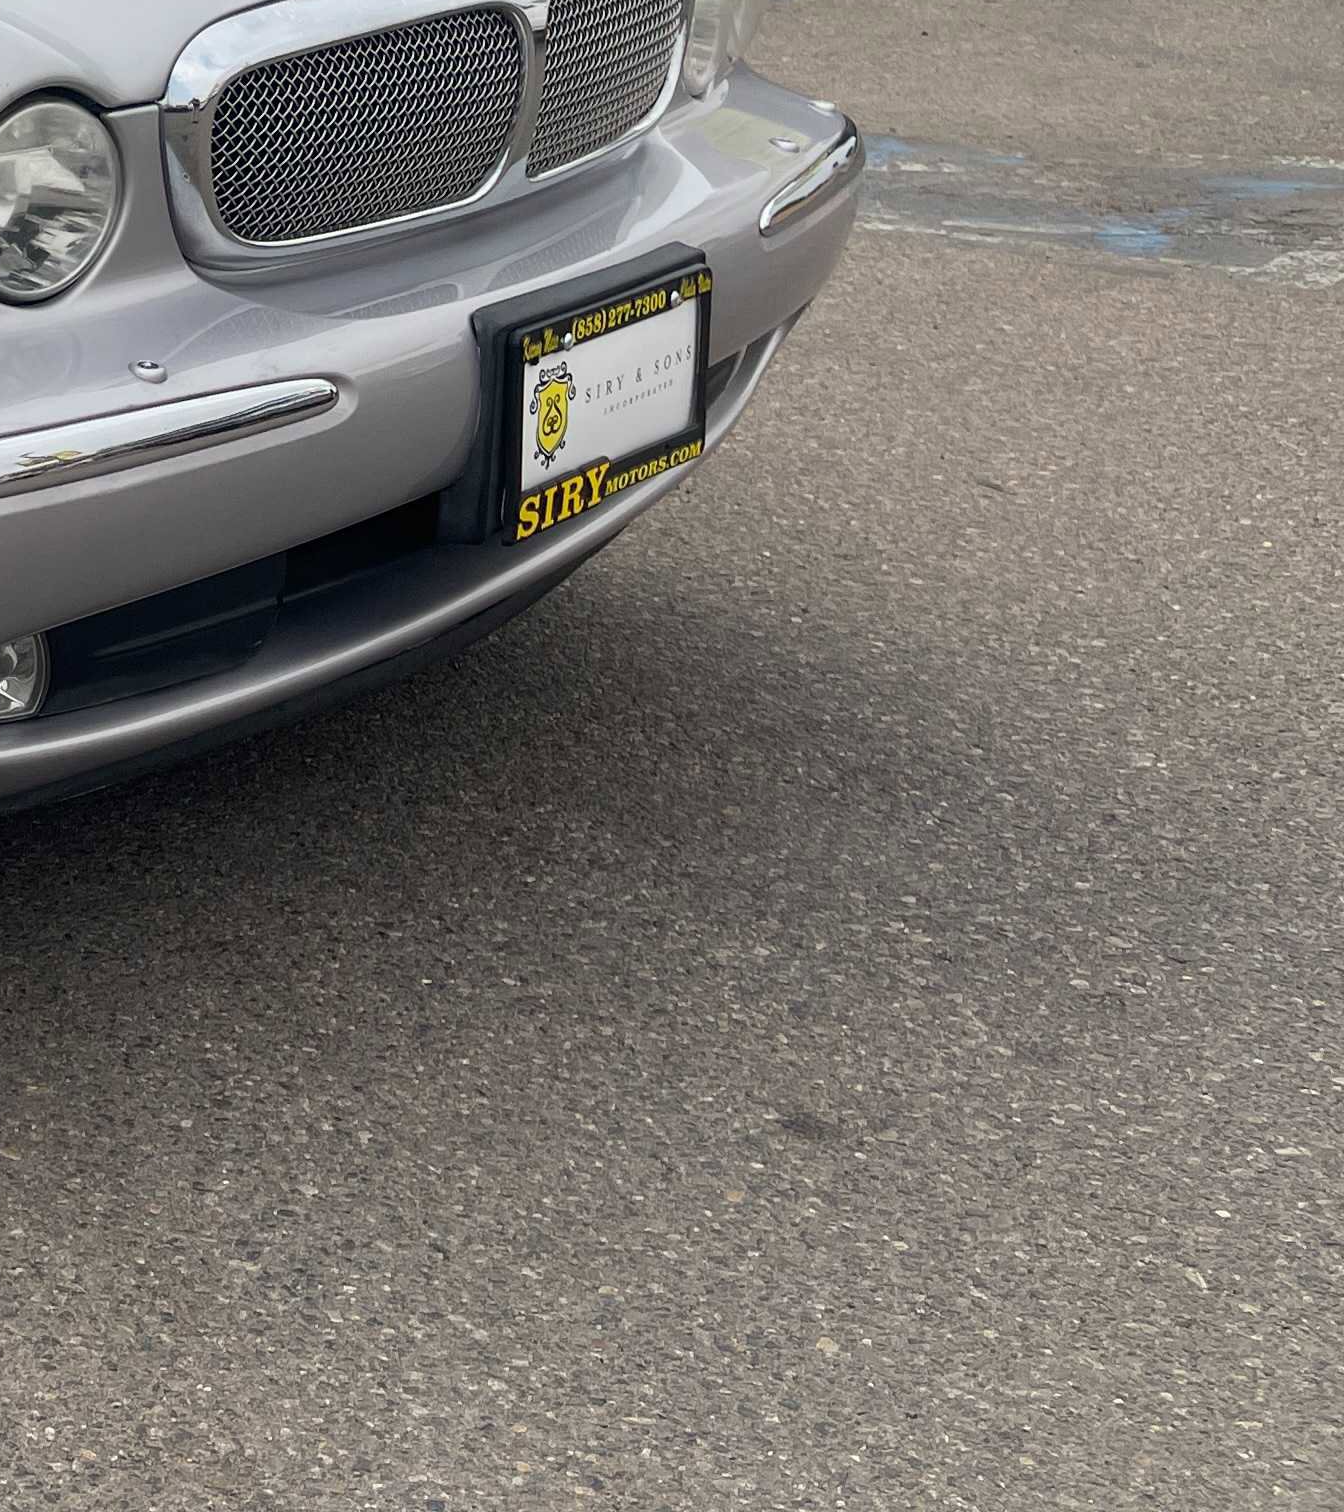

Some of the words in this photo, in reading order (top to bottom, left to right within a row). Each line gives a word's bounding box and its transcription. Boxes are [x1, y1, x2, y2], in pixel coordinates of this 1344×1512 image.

[572, 310, 607, 343] (858)
[608, 290, 666, 328] 277-7300
[584, 374, 625, 404] SIRY
[635, 368, 643, 383] &
[654, 344, 692, 375] SONS
[516, 462, 610, 541] SIRY
[605, 440, 703, 498] MOTORS.COM
